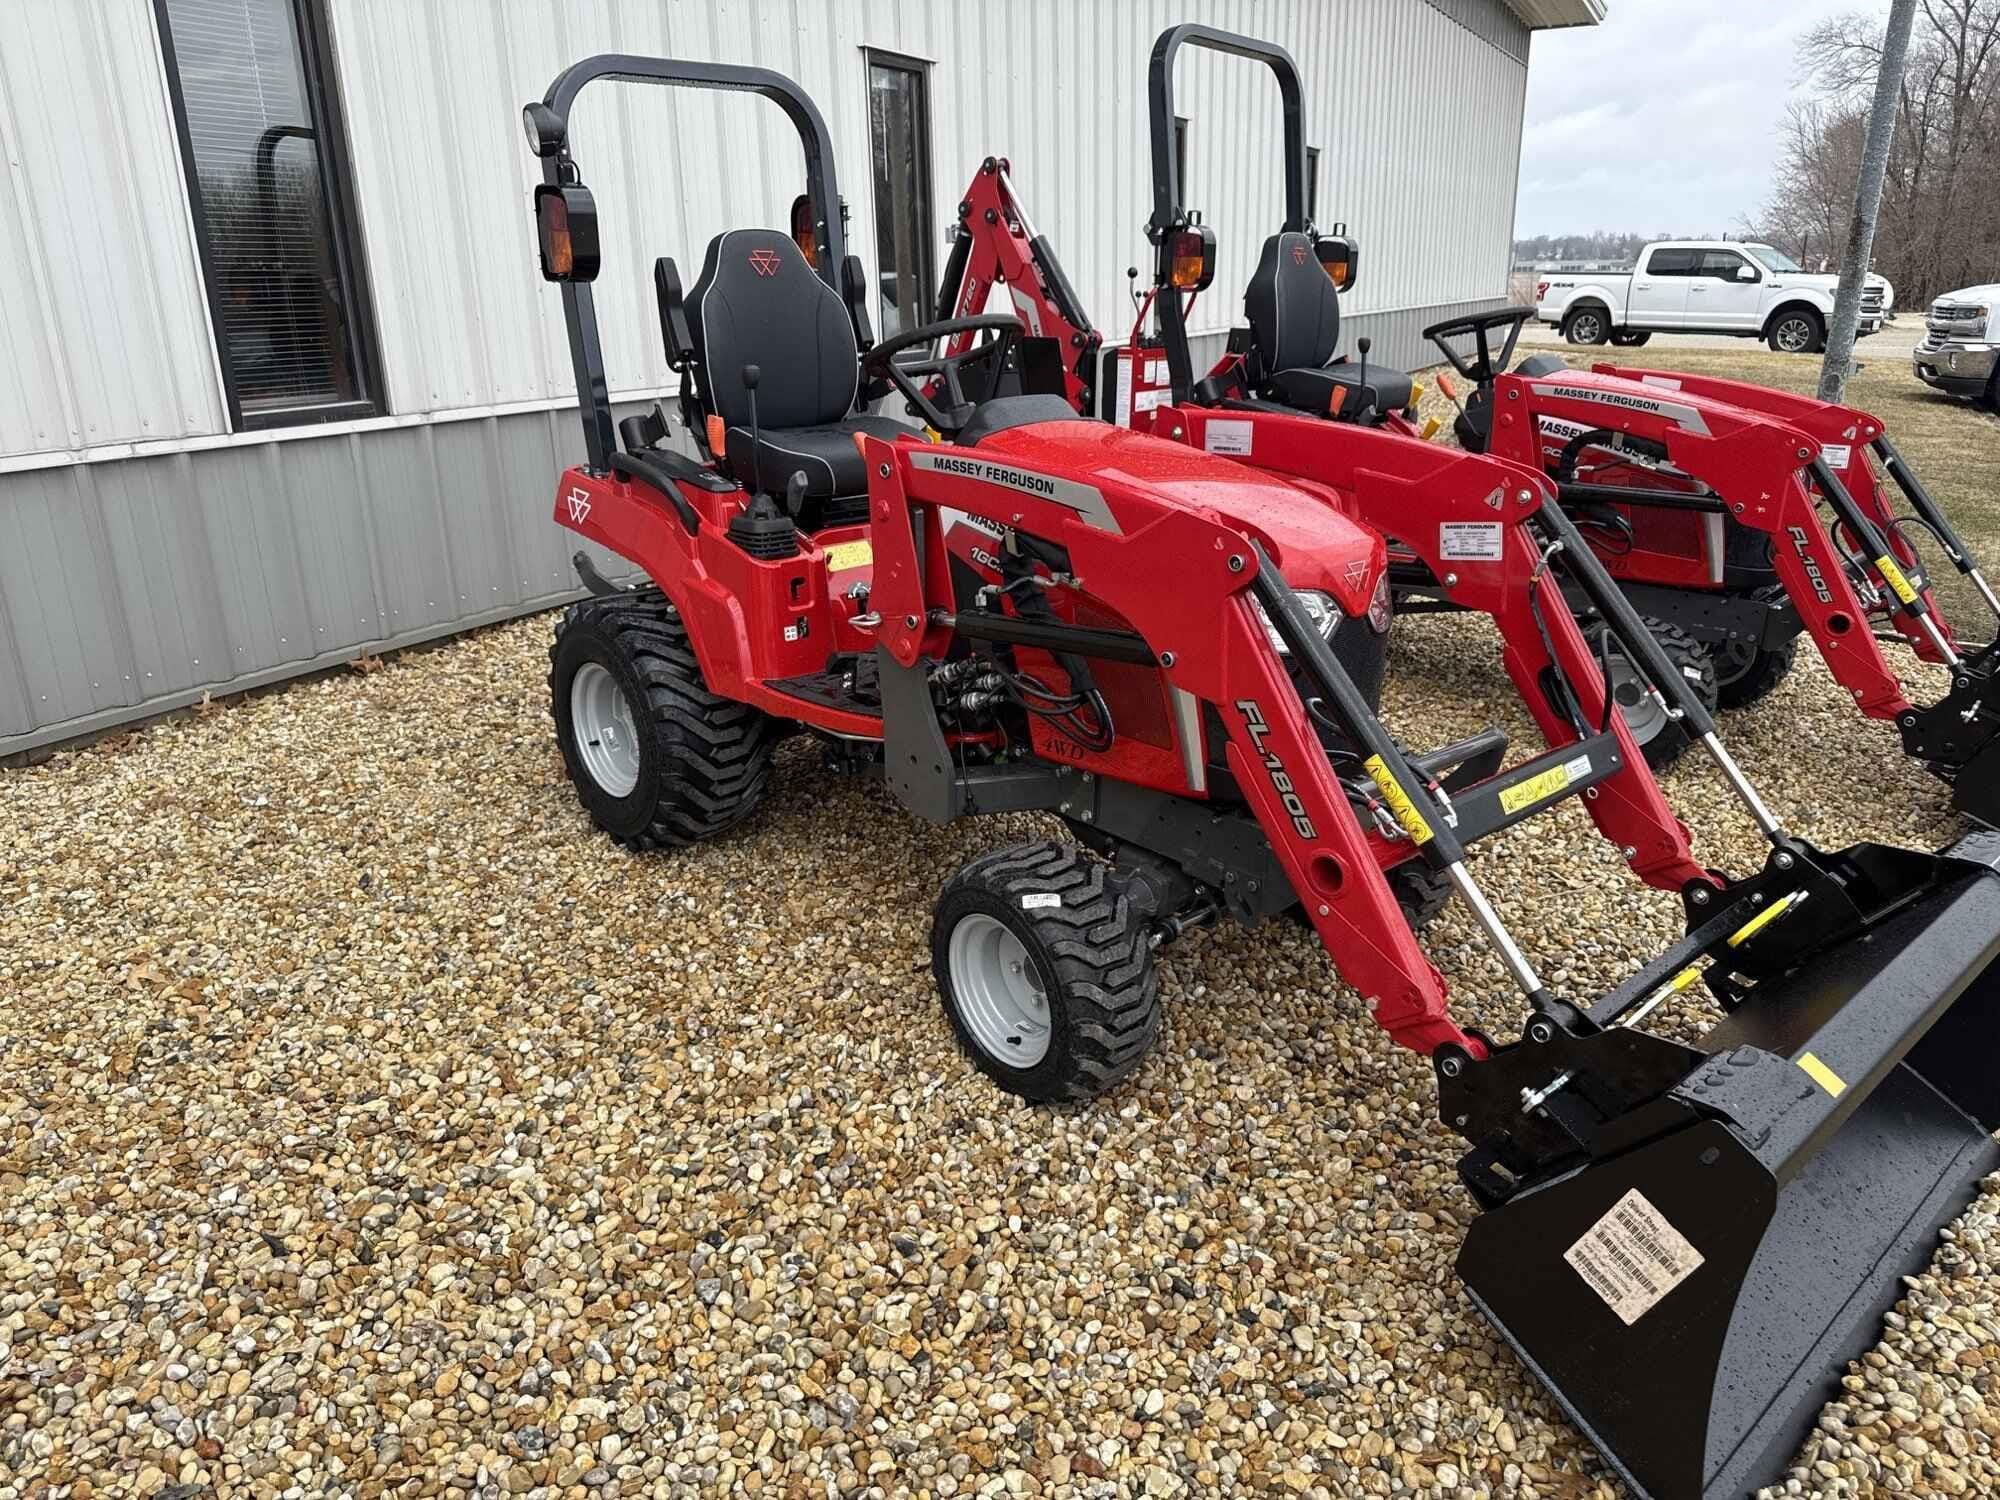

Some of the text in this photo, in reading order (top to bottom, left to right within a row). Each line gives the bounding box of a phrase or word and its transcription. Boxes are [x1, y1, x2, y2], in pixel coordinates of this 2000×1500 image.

[1553, 388, 1660, 411] MASSEY FERGUSON
[934, 457, 1054, 494] MASSEY FERGUSON
[966, 512, 1008, 536] MASS
